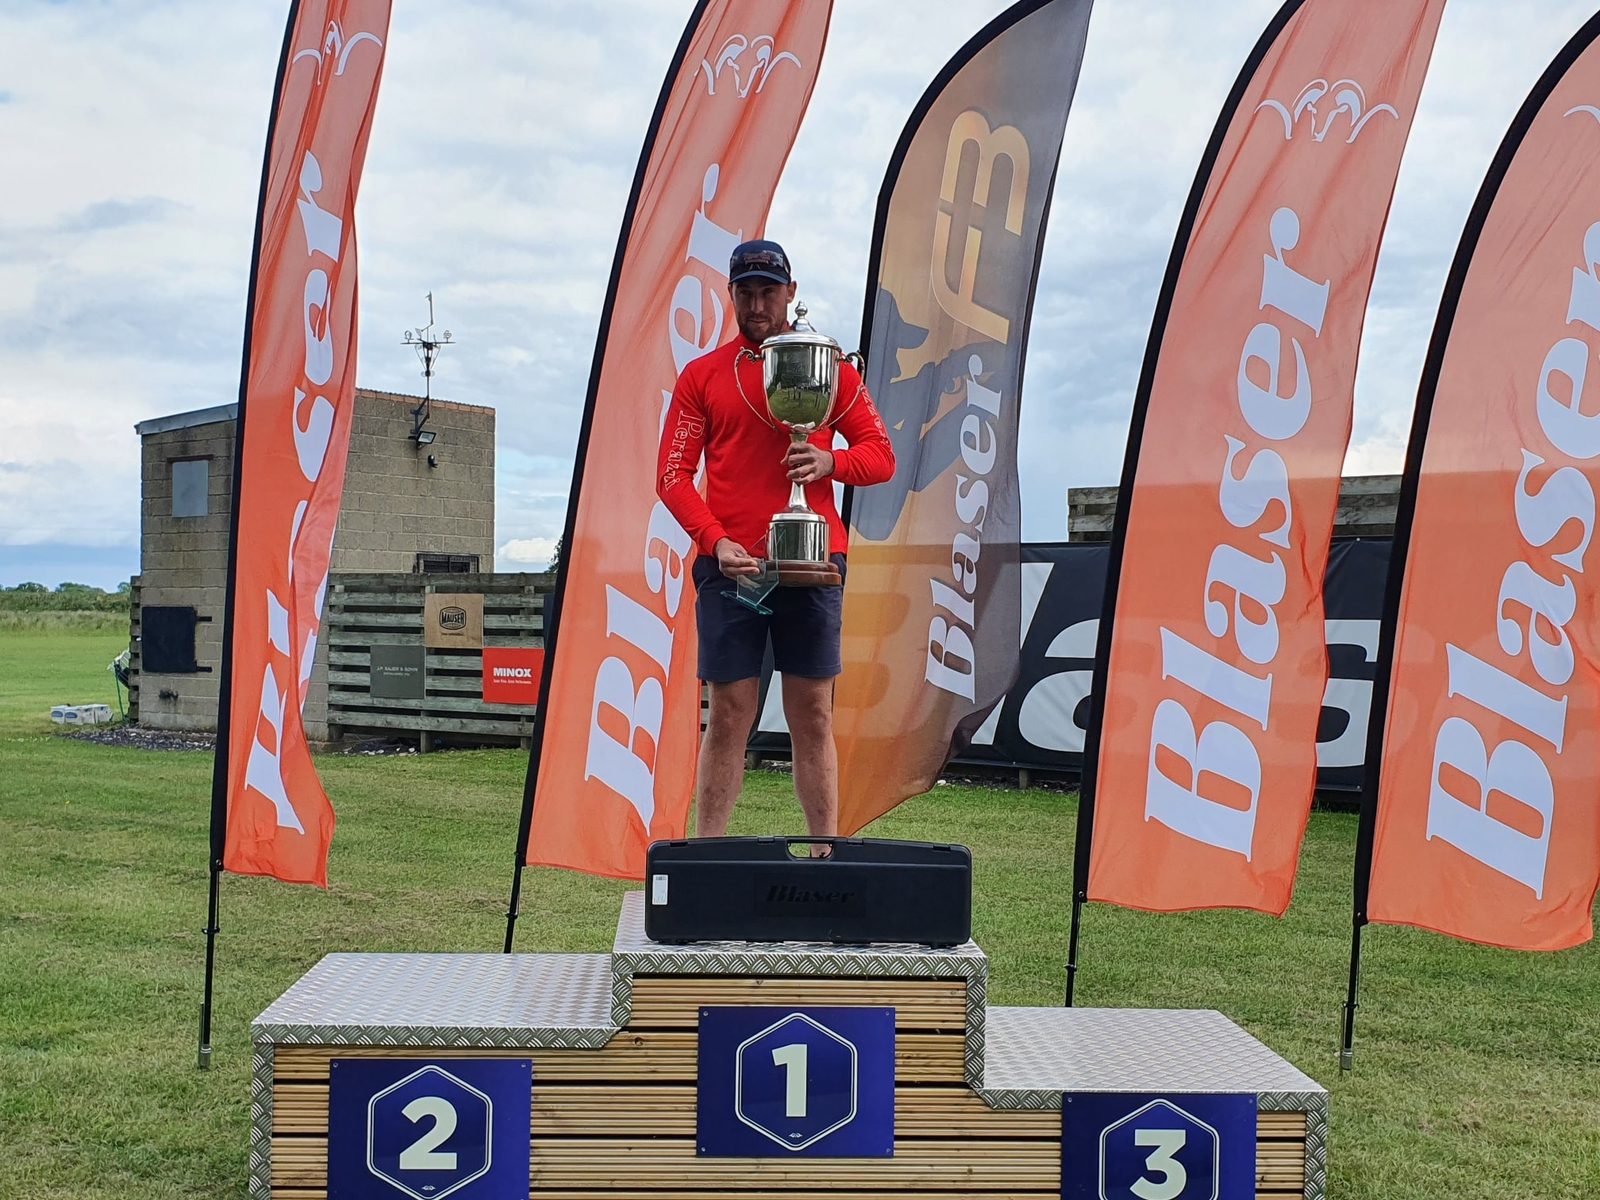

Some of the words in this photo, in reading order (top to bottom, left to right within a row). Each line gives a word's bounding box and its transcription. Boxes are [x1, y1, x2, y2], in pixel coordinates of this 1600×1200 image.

[663, 409, 706, 492] Perazzi
[924, 354, 1003, 702] Blaser
[1145, 207, 1330, 862] Blaser
[493, 667, 532, 678] MINOX
[765, 884, 855, 904] Blaser
[772, 1044, 808, 1117] 1
[399, 1096, 458, 1170] 2
[1129, 1129, 1187, 1200] 3
